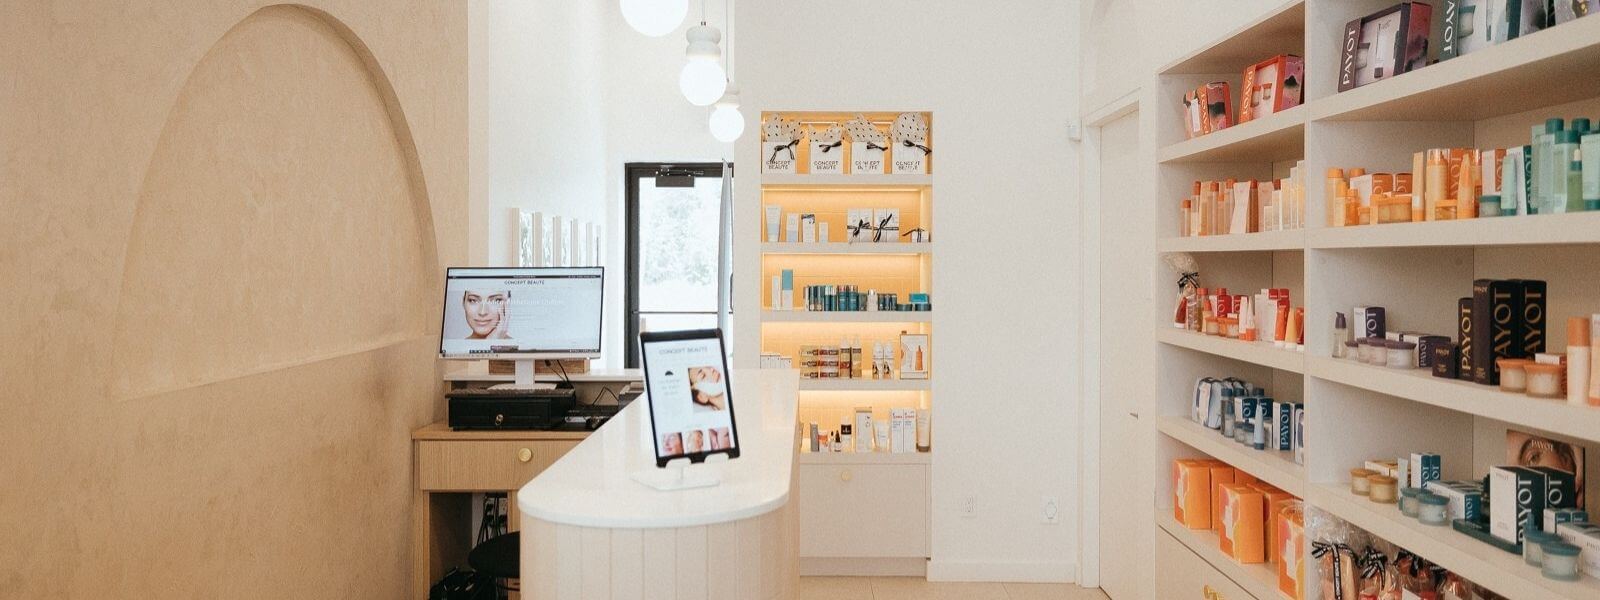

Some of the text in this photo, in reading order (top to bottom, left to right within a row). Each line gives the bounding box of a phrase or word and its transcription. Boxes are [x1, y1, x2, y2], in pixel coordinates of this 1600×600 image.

[1443, 0, 1456, 54] AYOT
[1342, 27, 1357, 85] PAYOT
[1366, 310, 1377, 338] YOT
[1461, 304, 1471, 370] PAYOT
[1494, 287, 1511, 372] AYOT
[1525, 287, 1542, 356] AYOT
[1281, 407, 1289, 446] PAYOT
[1531, 439, 1553, 452] PAYOT
